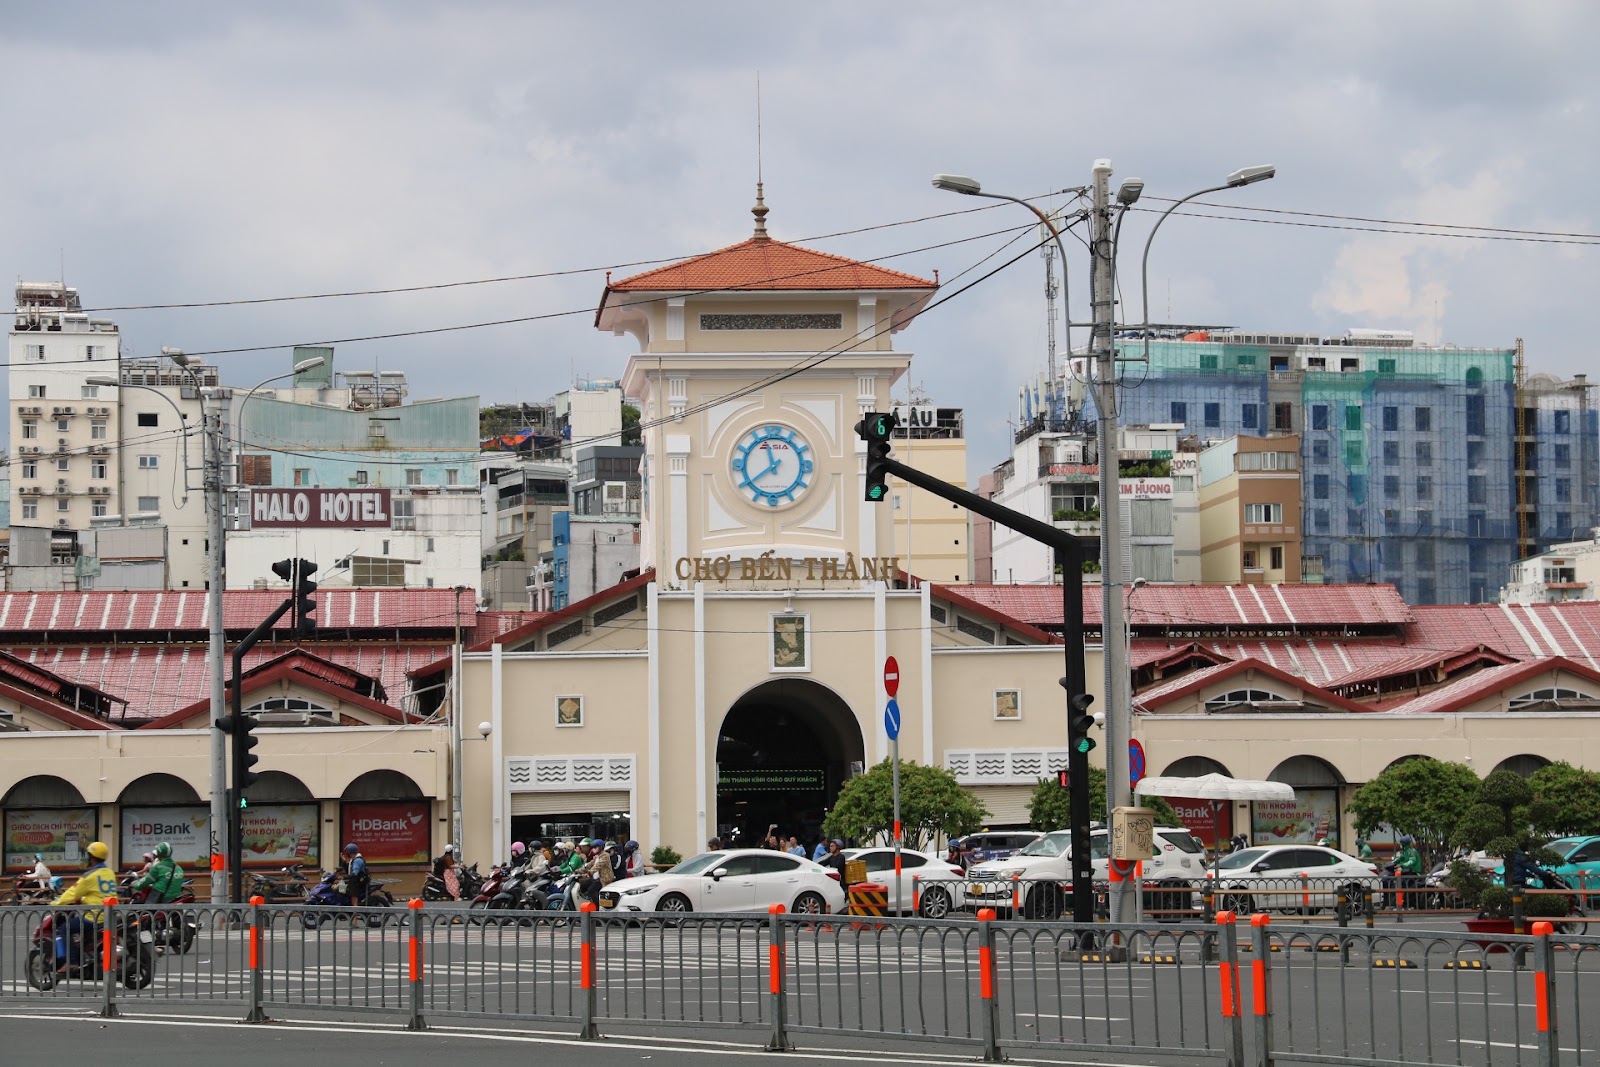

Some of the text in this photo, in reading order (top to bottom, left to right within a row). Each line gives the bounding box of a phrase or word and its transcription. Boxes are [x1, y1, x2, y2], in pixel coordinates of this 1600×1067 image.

[877, 417, 886, 436] 6
[254, 492, 388, 522] HALO HOTEL
[675, 549, 900, 583] CHỢ BẾN THÀNH
[1175, 806, 1210, 818] Bank
[11, 823, 32, 831] GIAO
[132, 823, 191, 836] HDBank
[352, 819, 408, 831] HDBank
